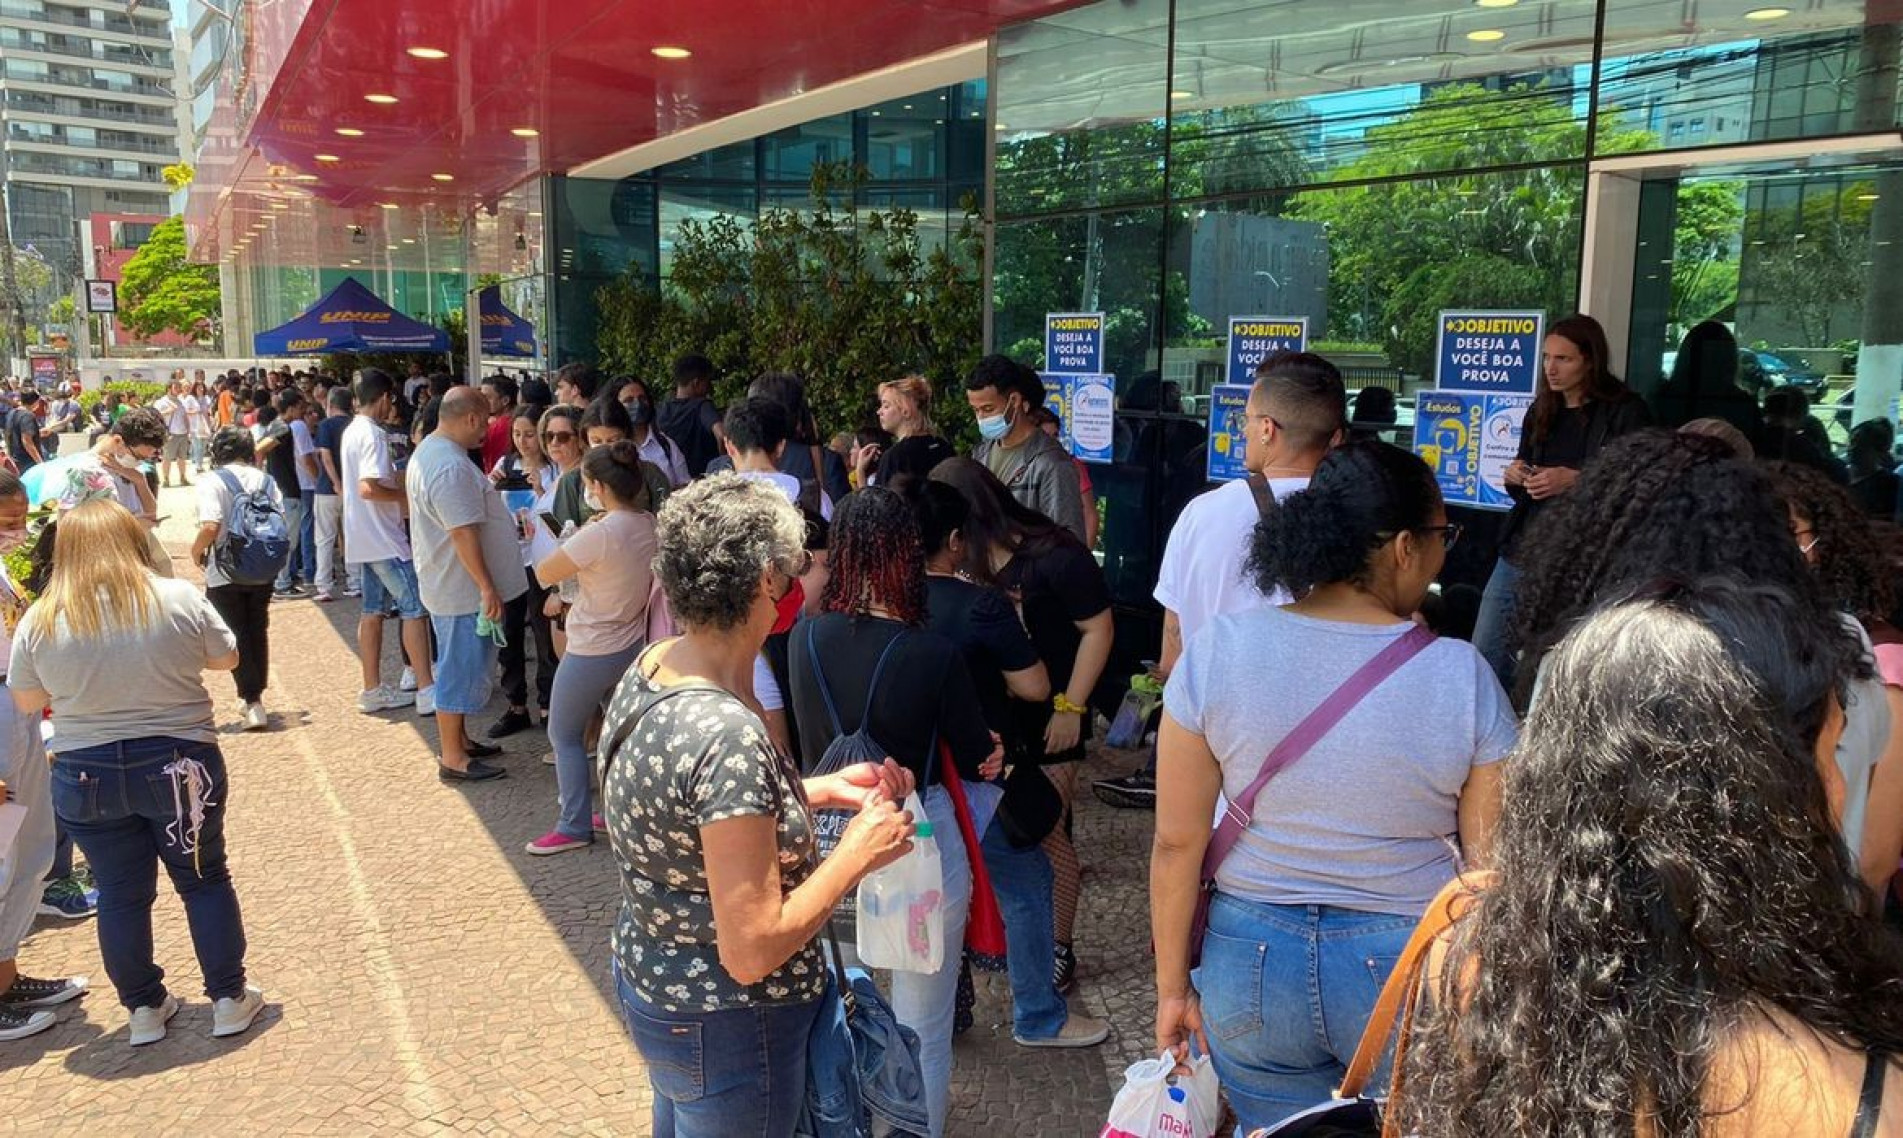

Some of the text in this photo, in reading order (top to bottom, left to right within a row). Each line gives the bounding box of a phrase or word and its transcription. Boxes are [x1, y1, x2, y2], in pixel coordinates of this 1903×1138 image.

[1061, 318, 1098, 330] OBJETIVO
[1248, 323, 1301, 337] OBJETIVO
[1466, 319, 1534, 334] OBJETIVO
[1056, 332, 1092, 342] DESEJA A
[287, 338, 328, 350] UNIP
[1053, 342, 1094, 354] VOCÊ BOA
[1242, 339, 1279, 350] DESEJA
[1456, 337, 1521, 350] DESEJA A
[1060, 356, 1087, 366] PROVA
[1451, 351, 1524, 366] VOCÊ BOA
[1461, 369, 1510, 382] PROVA
[1426, 402, 1461, 413] Estudos
[1466, 405, 1482, 473] OBJETIVO
